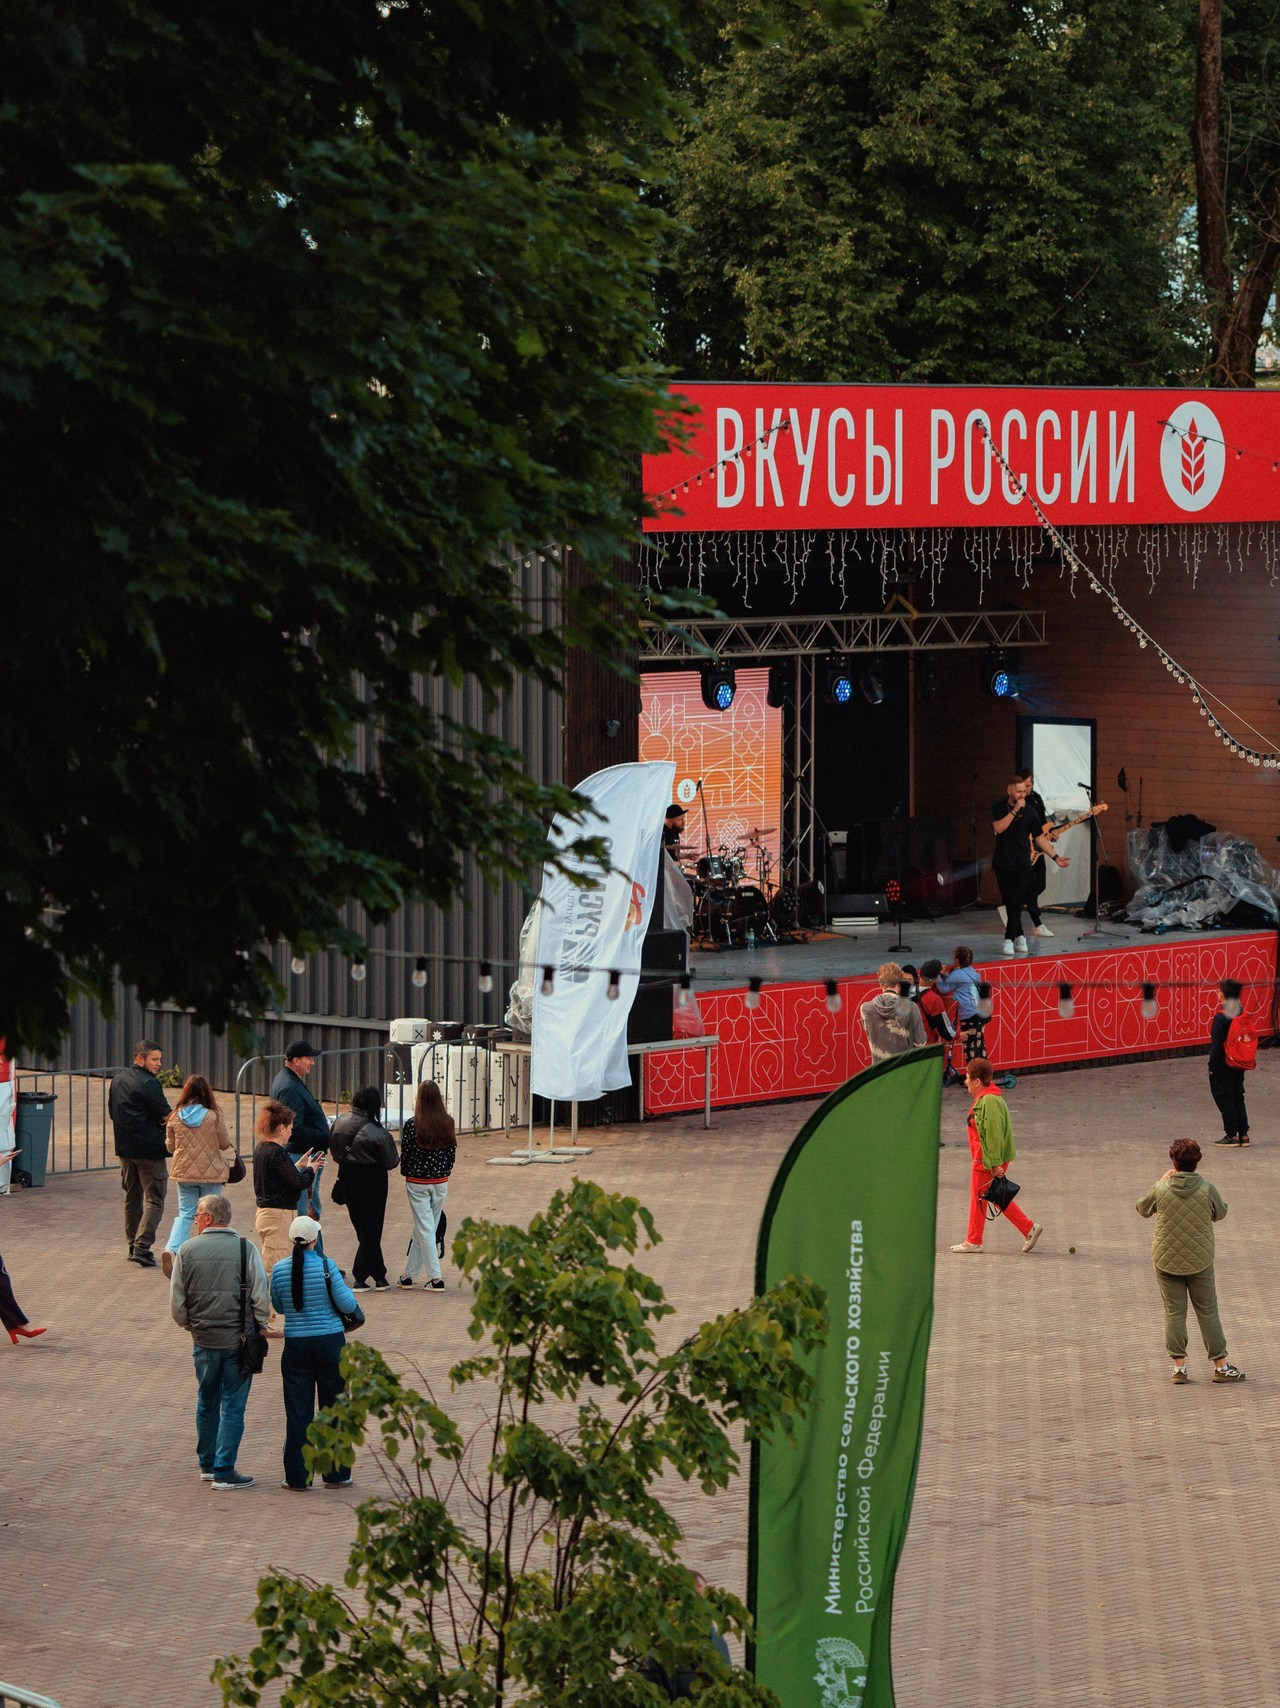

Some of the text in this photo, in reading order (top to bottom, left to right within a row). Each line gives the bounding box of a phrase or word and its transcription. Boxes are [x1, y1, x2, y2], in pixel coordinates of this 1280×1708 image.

[716, 407, 1135, 508] ВКУСЫ РОССИИ
[824, 1219, 864, 1615] Министерство сельского хозяйства
[853, 1351, 891, 1614] Российской Федерации
